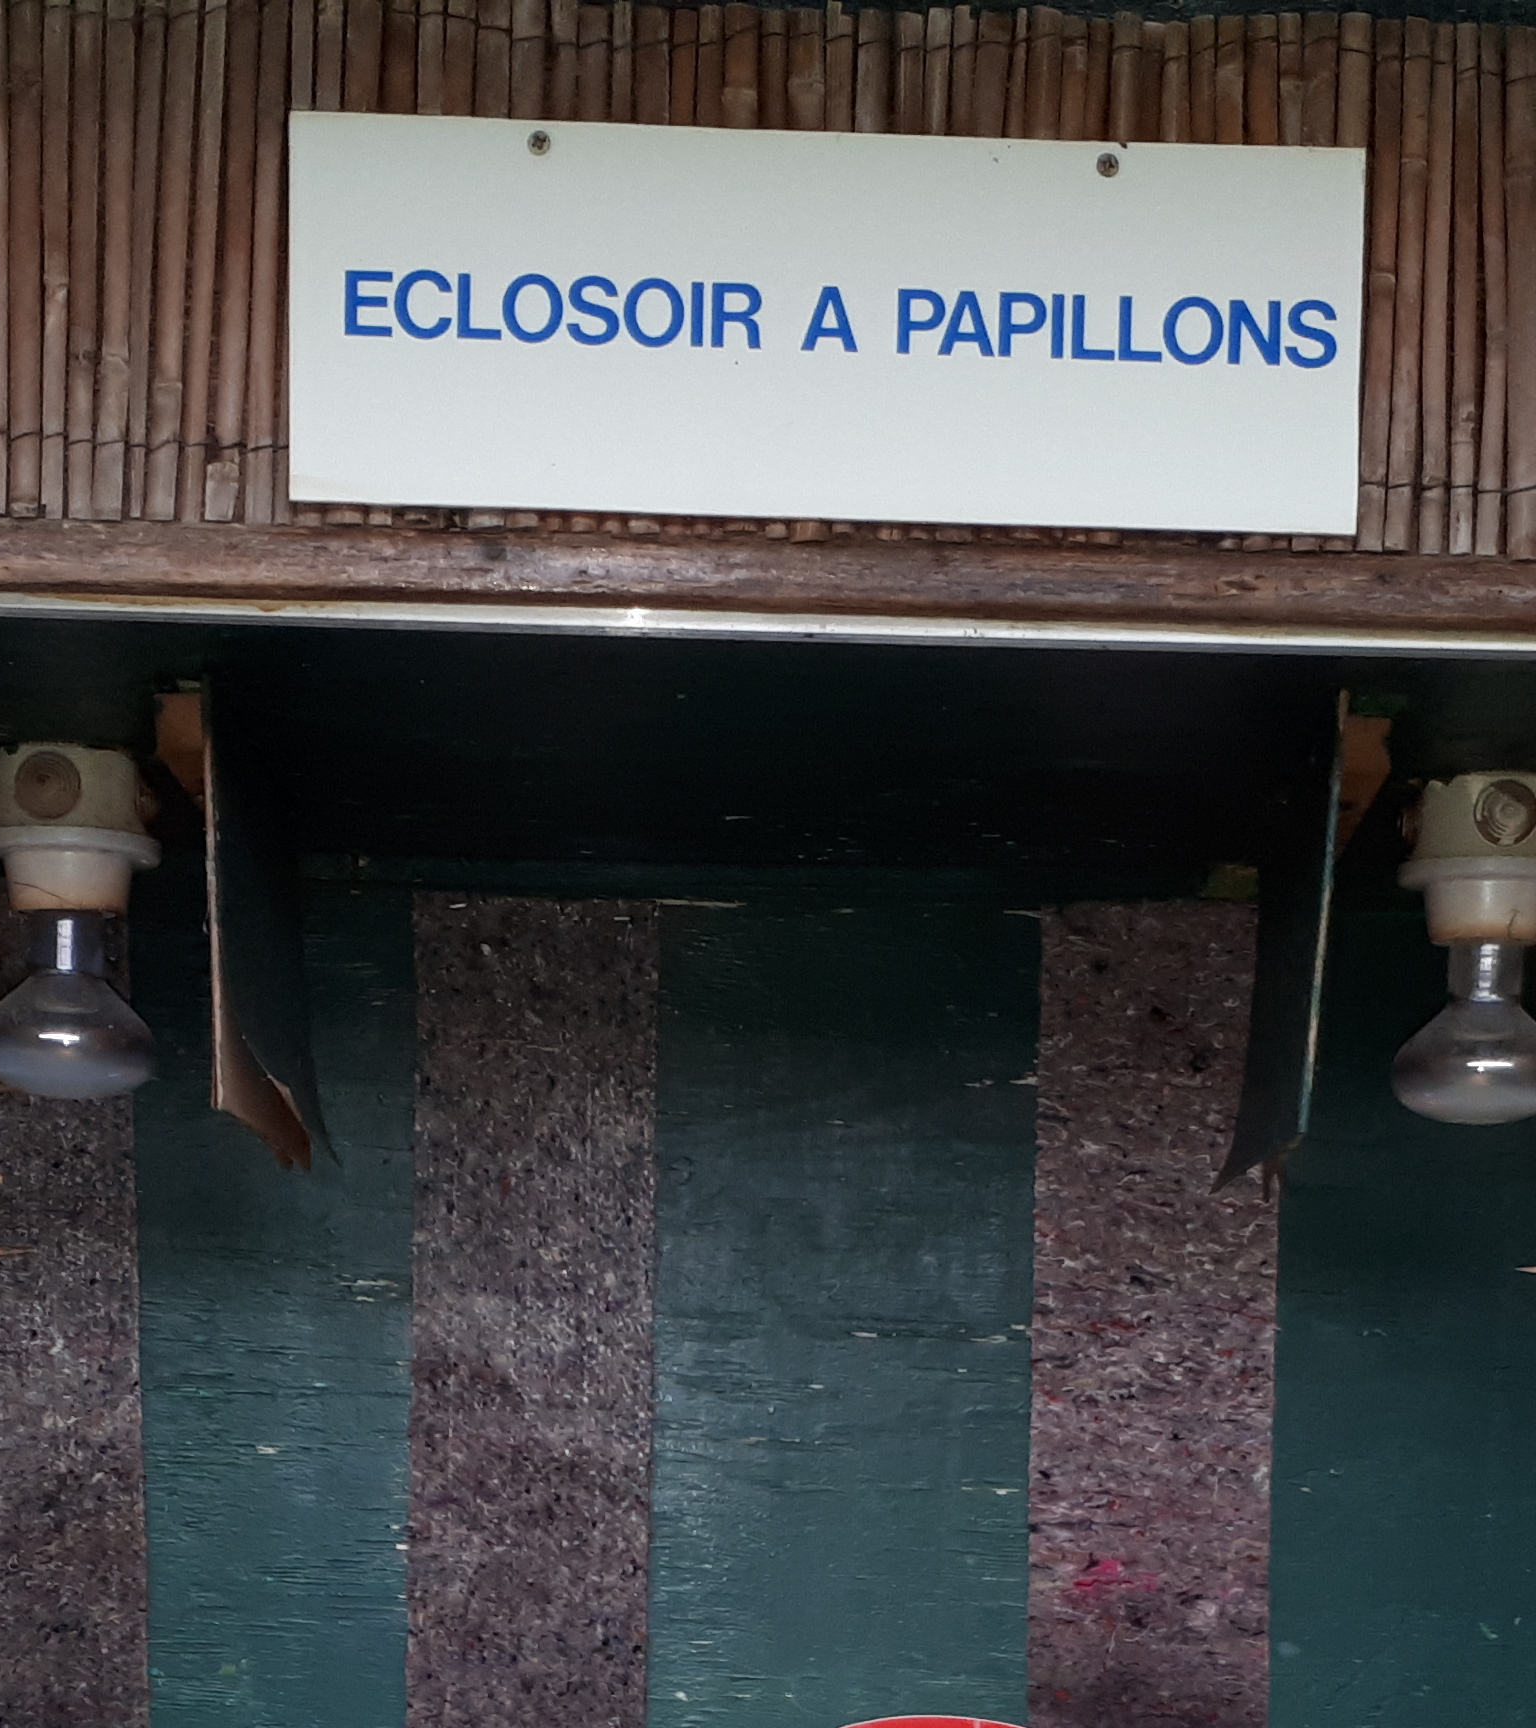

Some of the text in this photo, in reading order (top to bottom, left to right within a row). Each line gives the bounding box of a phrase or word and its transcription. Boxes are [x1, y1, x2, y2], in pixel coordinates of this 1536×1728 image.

[343, 268, 1339, 369] ECLOSOIR A PAPILLONS
